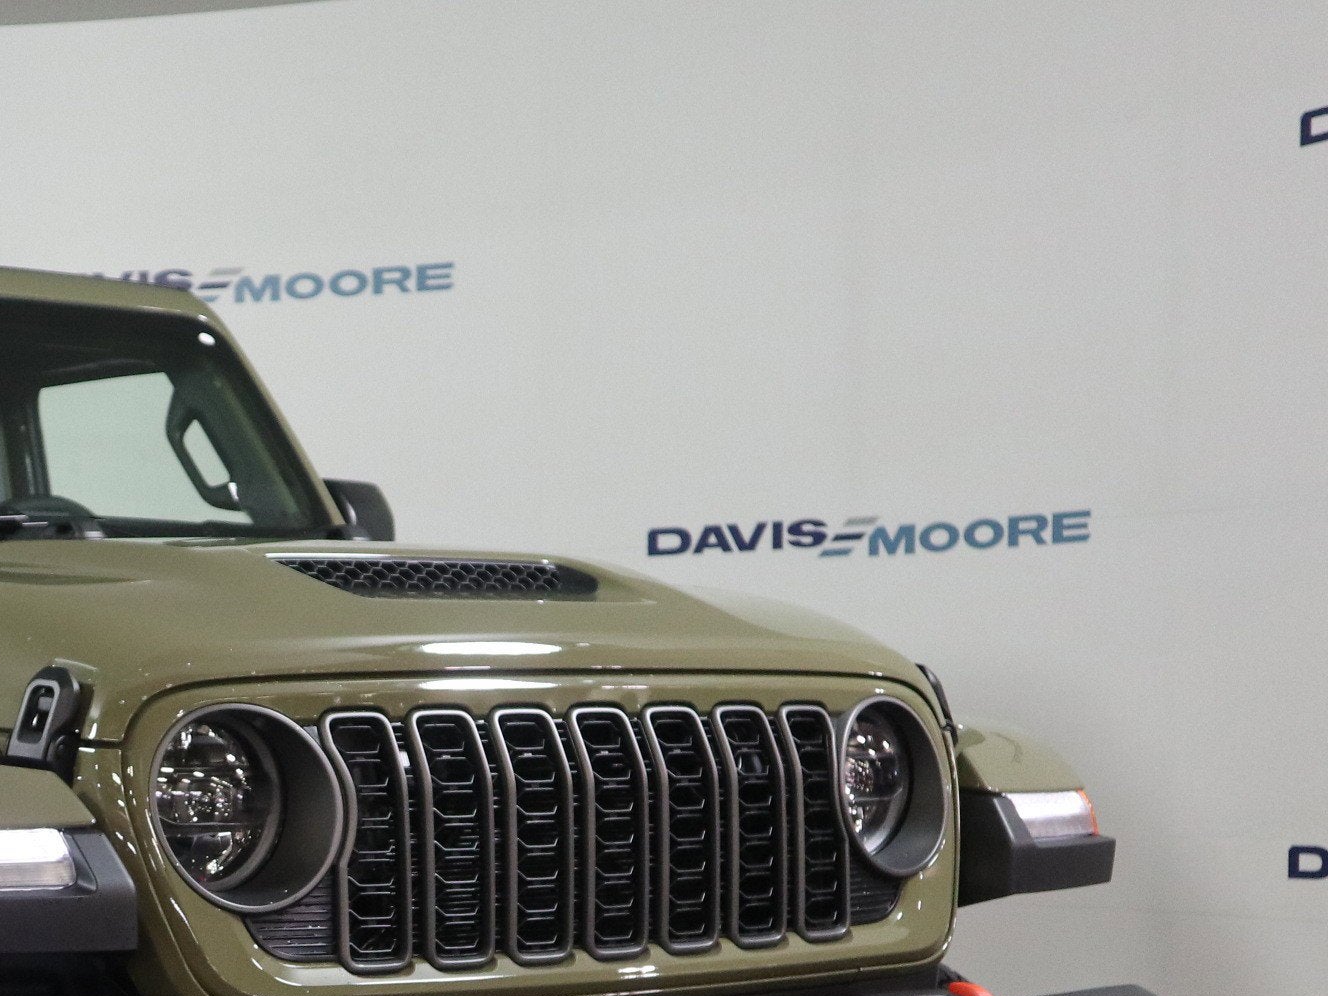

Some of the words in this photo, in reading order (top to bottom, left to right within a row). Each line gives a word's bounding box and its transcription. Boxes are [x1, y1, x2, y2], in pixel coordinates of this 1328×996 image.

[233, 262, 455, 304] MOORE
[646, 518, 828, 557] DAVIS
[868, 510, 1092, 557] MOORE
